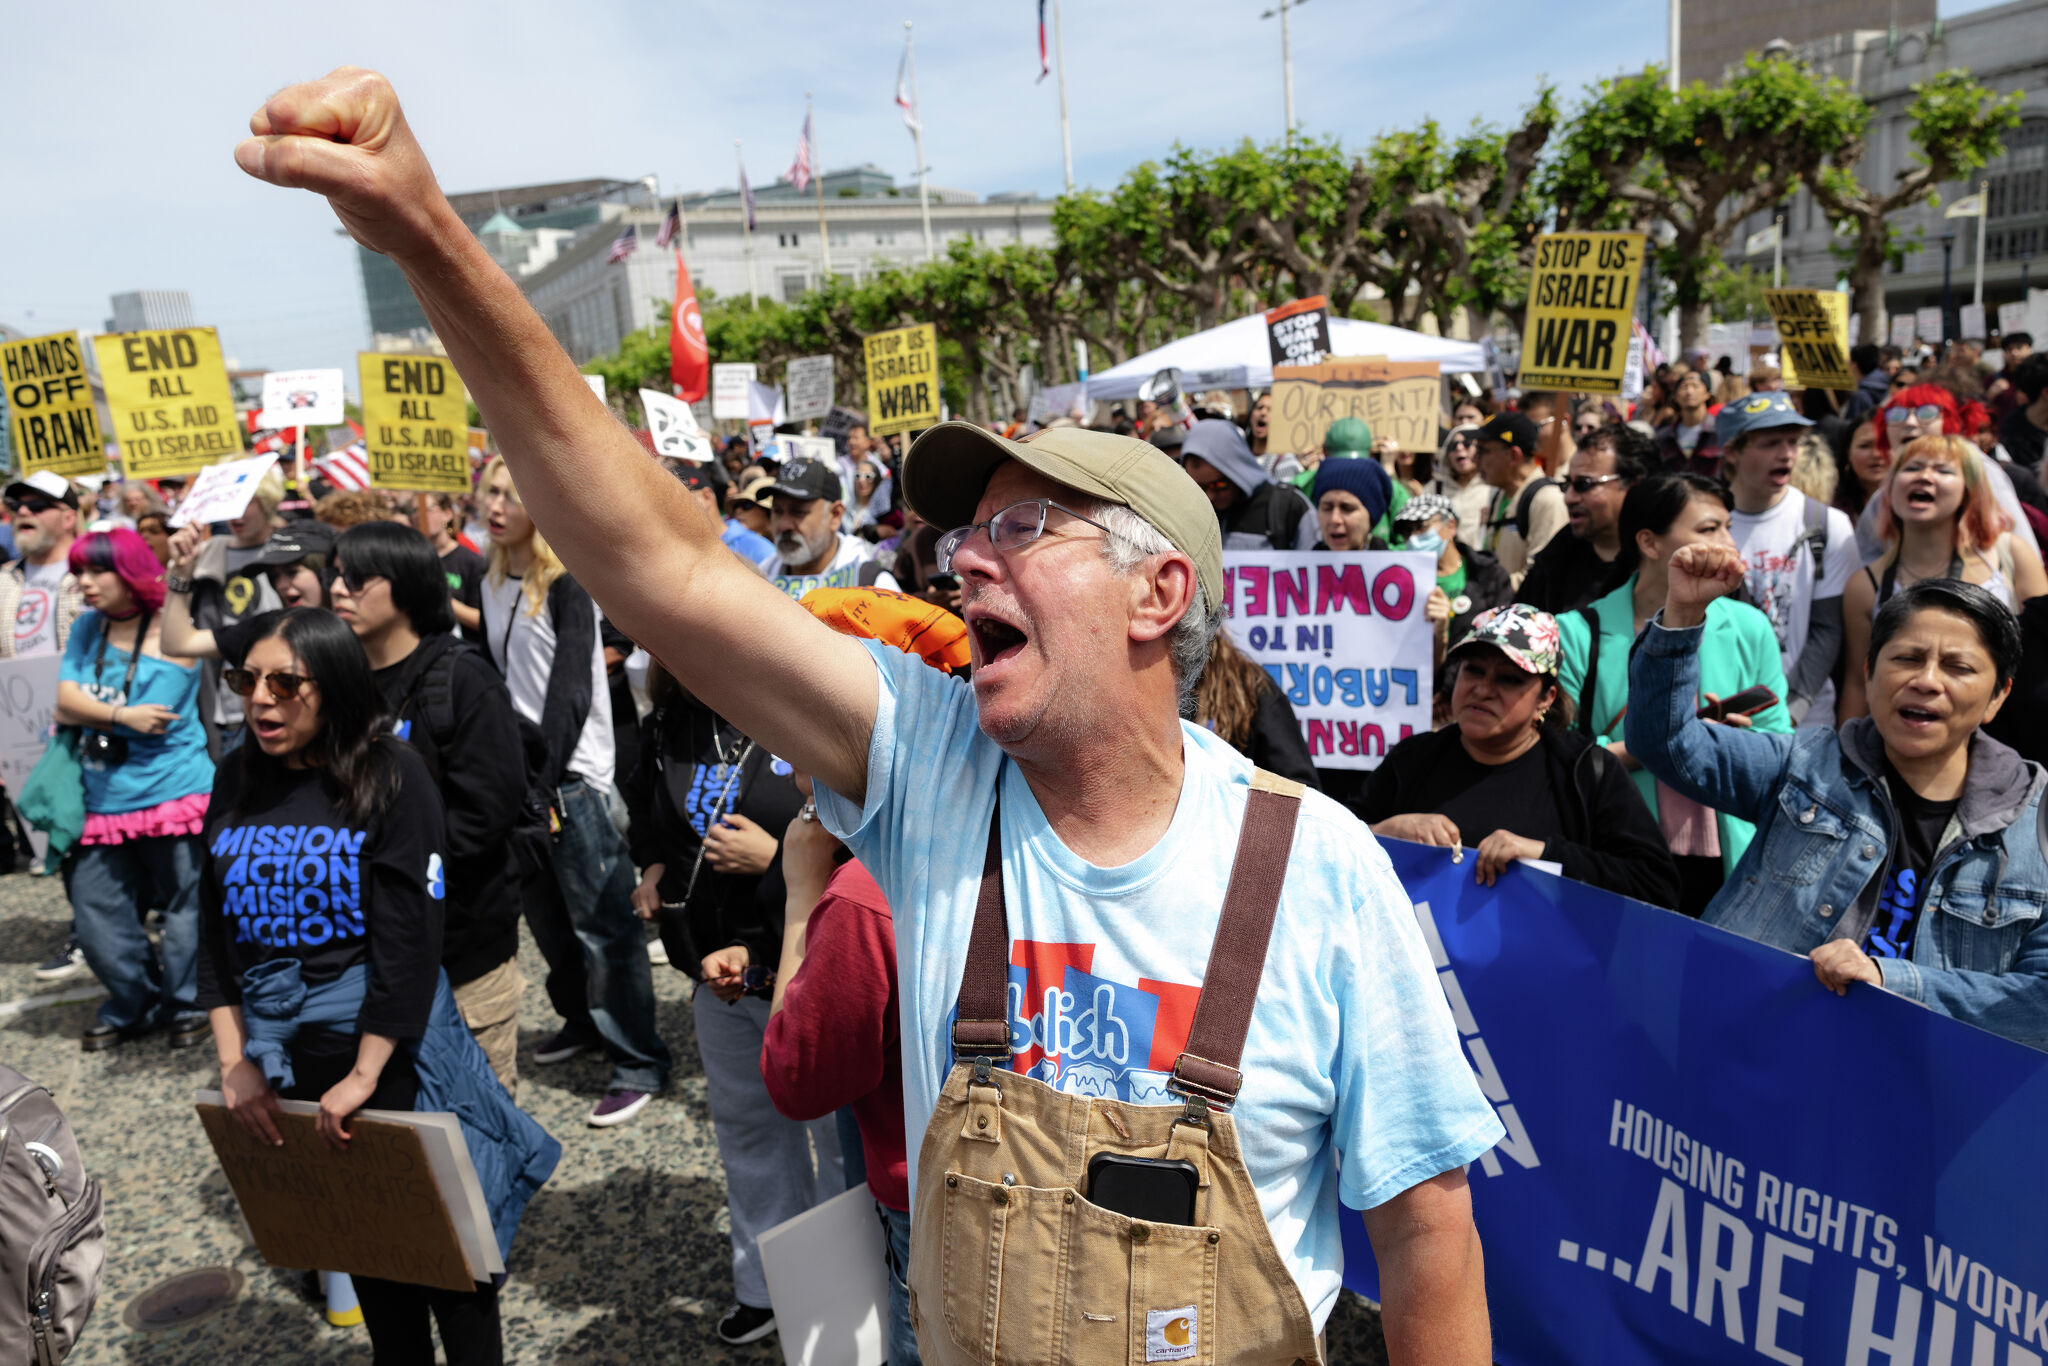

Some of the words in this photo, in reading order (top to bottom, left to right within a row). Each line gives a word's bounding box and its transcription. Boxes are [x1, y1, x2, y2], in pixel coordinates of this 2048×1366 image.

[1539, 239, 1591, 269] STOP
[1599, 240, 1637, 270] US-
[1535, 274, 1629, 310] ISRAELI
[1272, 312, 1321, 337] STOP
[1277, 326, 1319, 348] WAR
[1778, 320, 1828, 338] OFF
[5, 337, 79, 382] HANDS
[122, 334, 198, 372] END
[869, 335, 901, 358] STOP
[1285, 340, 1314, 357] ON
[1533, 319, 1616, 371] WAR
[383, 360, 445, 395] END
[872, 352, 930, 380] ISRAELI
[13, 375, 84, 409] OFF
[149, 376, 192, 398] ALL
[878, 382, 930, 419] WAR
[130, 409, 177, 433] U.S.
[183, 405, 219, 428] AID
[400, 400, 435, 421] ALL
[1283, 385, 1337, 422] OUR
[1350, 387, 1434, 417] RENT!
[19, 407, 99, 461] IRAN!
[123, 438, 153, 459] TO
[159, 430, 236, 456] ISRAEL!
[380, 426, 418, 448] U.S.
[423, 429, 453, 449] AID
[1291, 421, 1330, 450] OU
[1370, 415, 1428, 447] ITY!
[374, 452, 394, 470] TO
[399, 453, 465, 473] ISRAEL!
[210, 824, 367, 858] MISSION
[223, 854, 361, 887] ACTION
[1008, 982, 1129, 1065] bolish
[1609, 1099, 1745, 1210] HOUSING
[1756, 1170, 1907, 1280] RIGHTS,
[1924, 1234, 2048, 1353] WORK
[1155, 1346, 1190, 1354] carhartt
